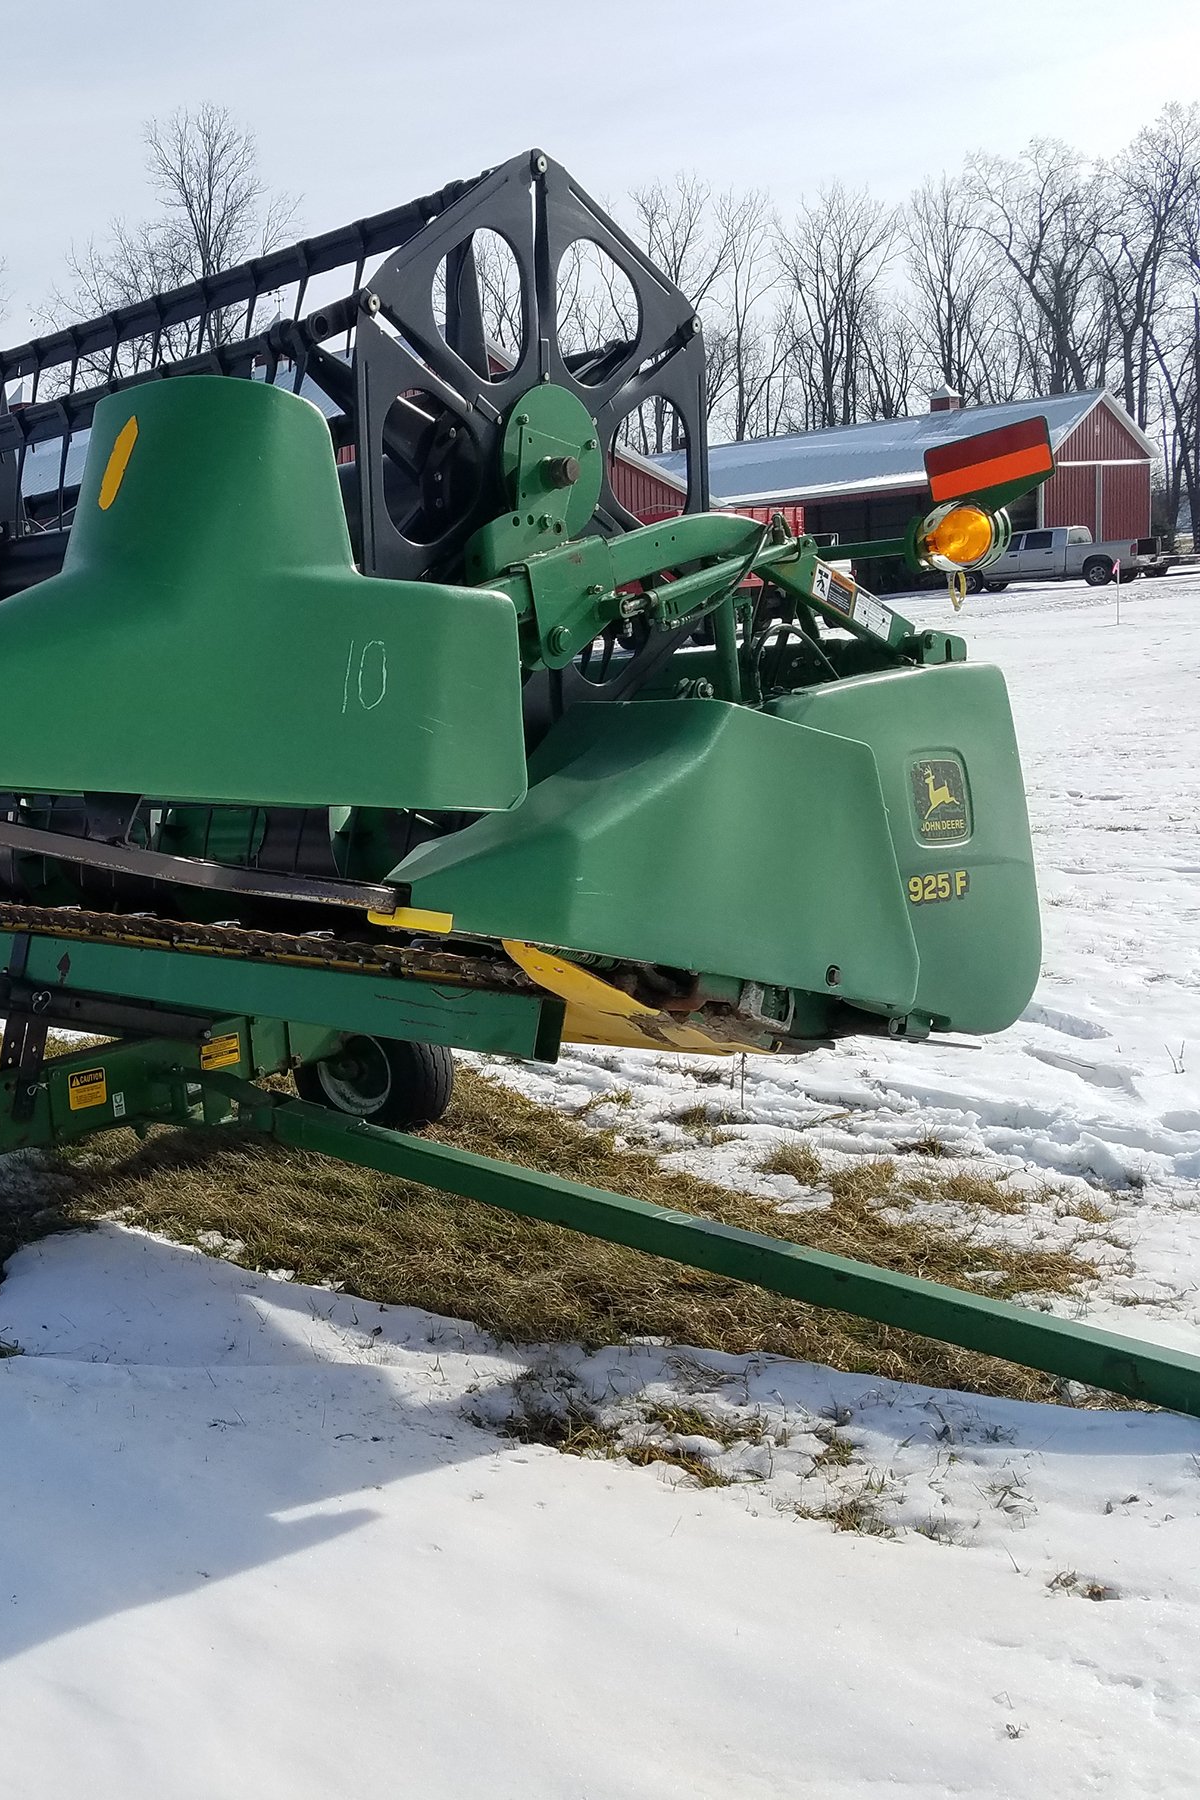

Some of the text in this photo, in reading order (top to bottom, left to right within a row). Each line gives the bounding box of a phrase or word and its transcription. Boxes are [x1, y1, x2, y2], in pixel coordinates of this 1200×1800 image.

[342, 640, 387, 713] 10
[920, 819, 965, 832] JOHN DEERE
[908, 870, 968, 902] 925 F
[79, 1071, 103, 1084] CAUTION
